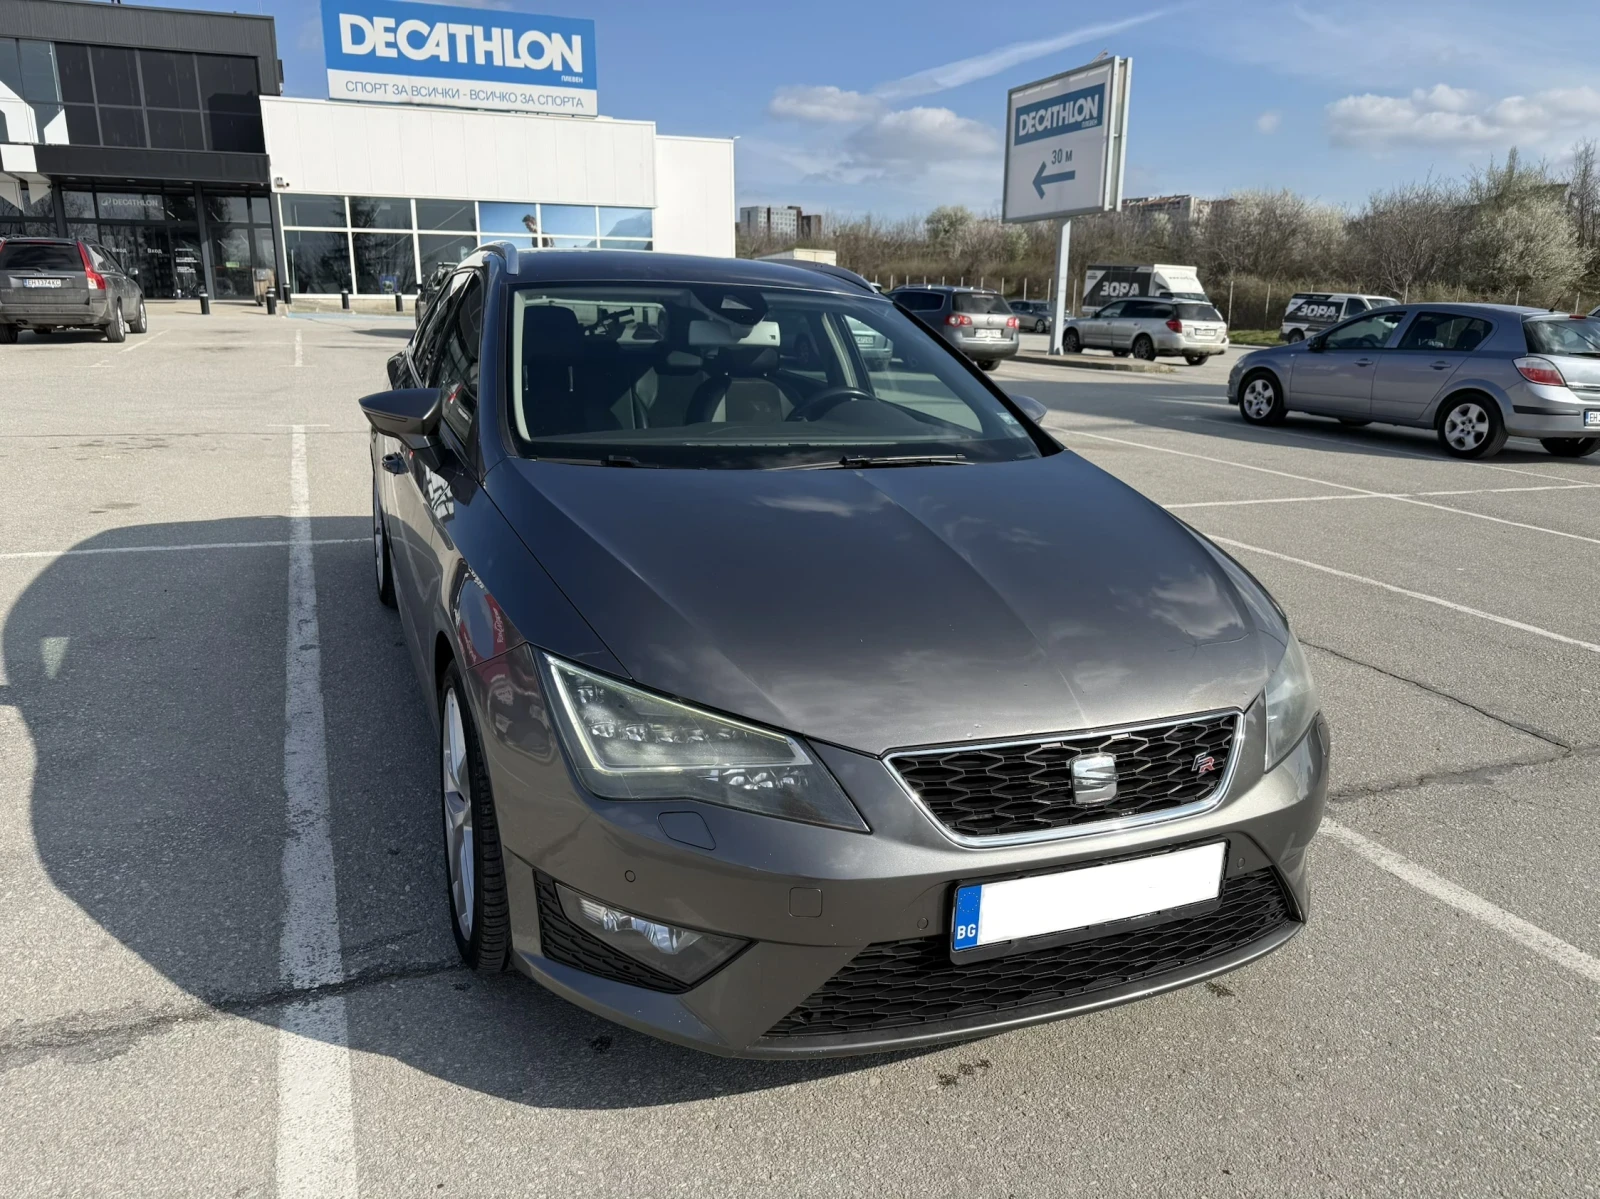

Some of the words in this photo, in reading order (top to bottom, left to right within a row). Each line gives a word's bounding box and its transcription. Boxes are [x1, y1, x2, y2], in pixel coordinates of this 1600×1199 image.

[339, 13, 583, 73] DECATHLON
[561, 76, 583, 84] ПЛЕВЕН
[345, 80, 389, 94] СПОРТ
[392, 84, 408, 96] ЗА
[411, 85, 460, 99] ВСИЧКИ
[469, 89, 517, 104] ВСИЧКО
[520, 94, 535, 105] ЗА
[537, 94, 584, 108] СПОРТА
[1019, 94, 1099, 136] DECATHLON
[1051, 148, 1063, 165] 30
[1100, 281, 1140, 296] ЗОРА
[1297, 304, 1336, 317] ЗОРА
[1191, 751, 1215, 773] FR
[957, 923, 976, 939] BG
